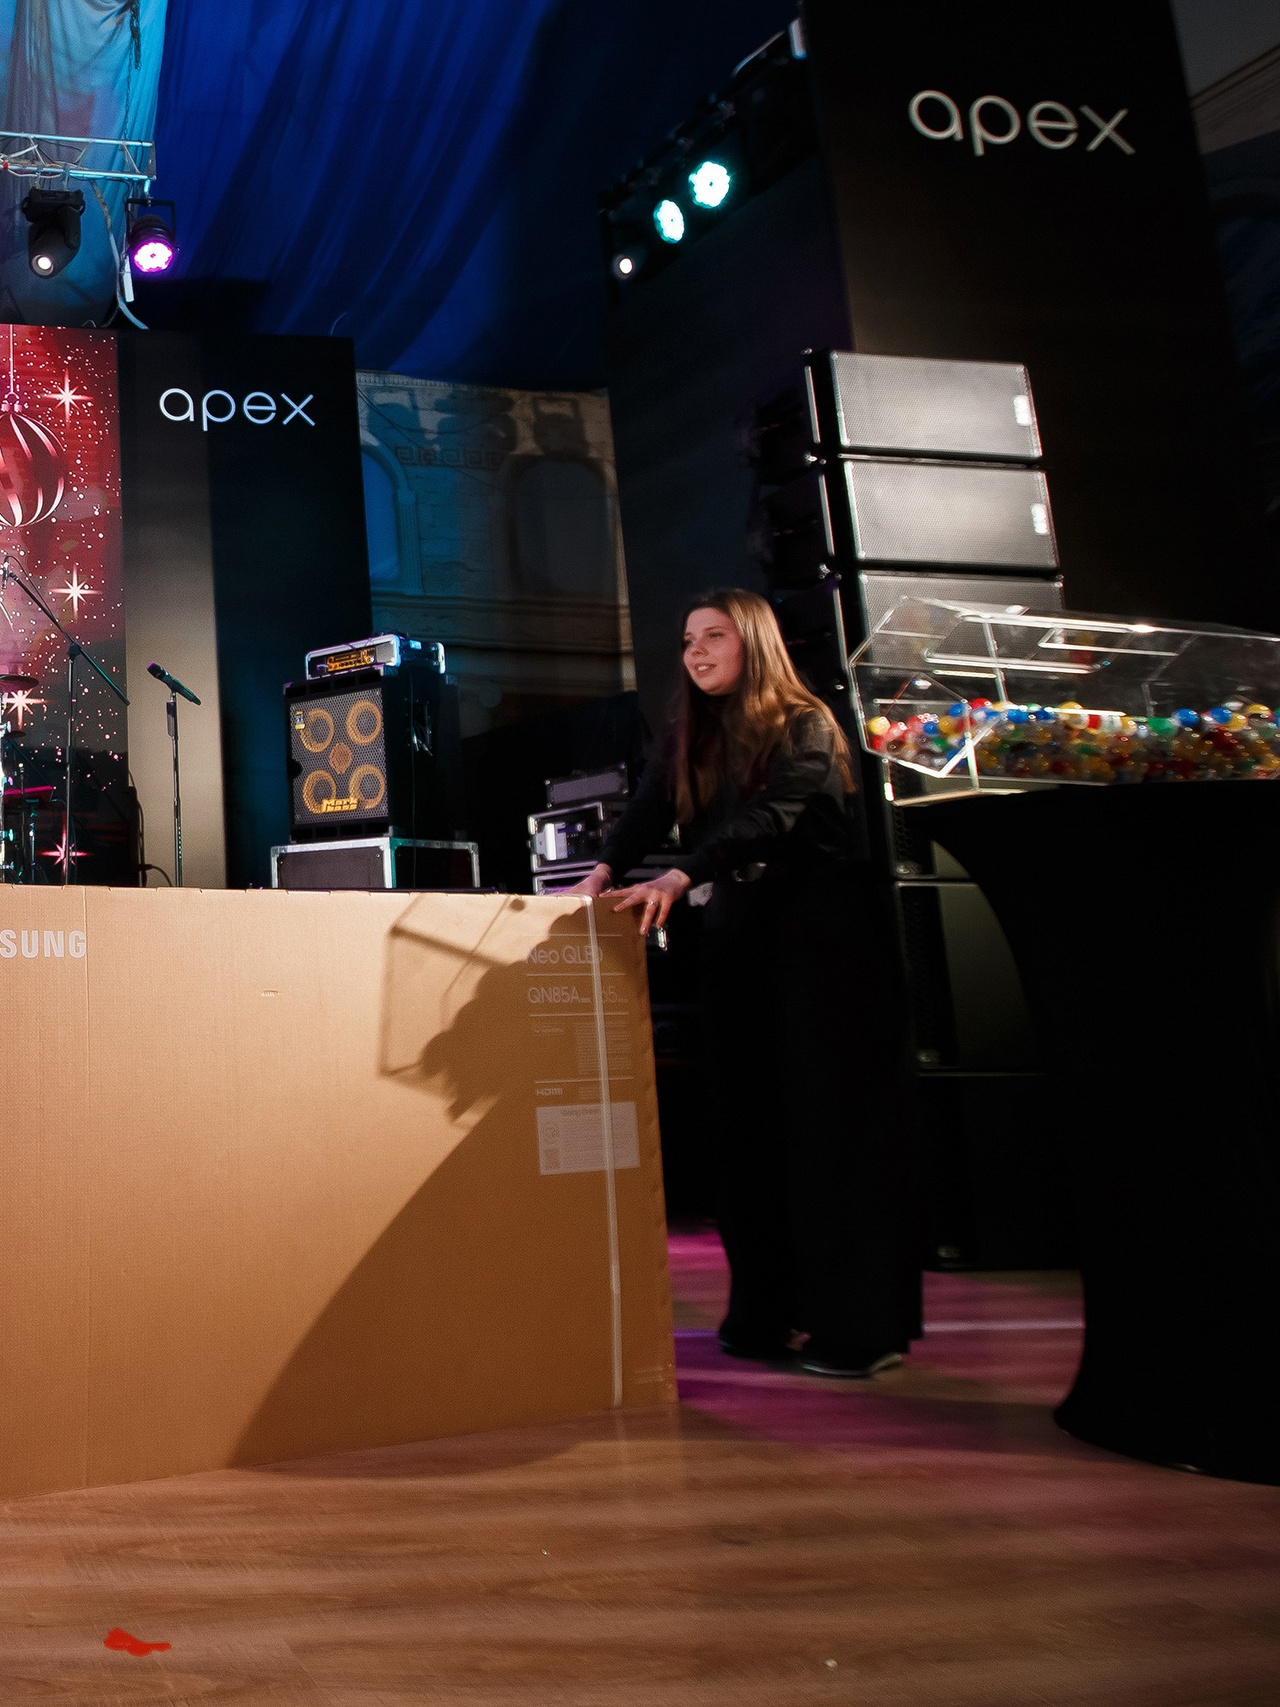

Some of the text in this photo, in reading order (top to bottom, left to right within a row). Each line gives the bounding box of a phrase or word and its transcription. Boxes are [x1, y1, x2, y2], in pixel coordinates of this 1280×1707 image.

[908, 89, 1136, 156] apex
[159, 387, 316, 432] apex
[525, 945, 559, 964] Neo
[527, 986, 580, 1004] QN85A
